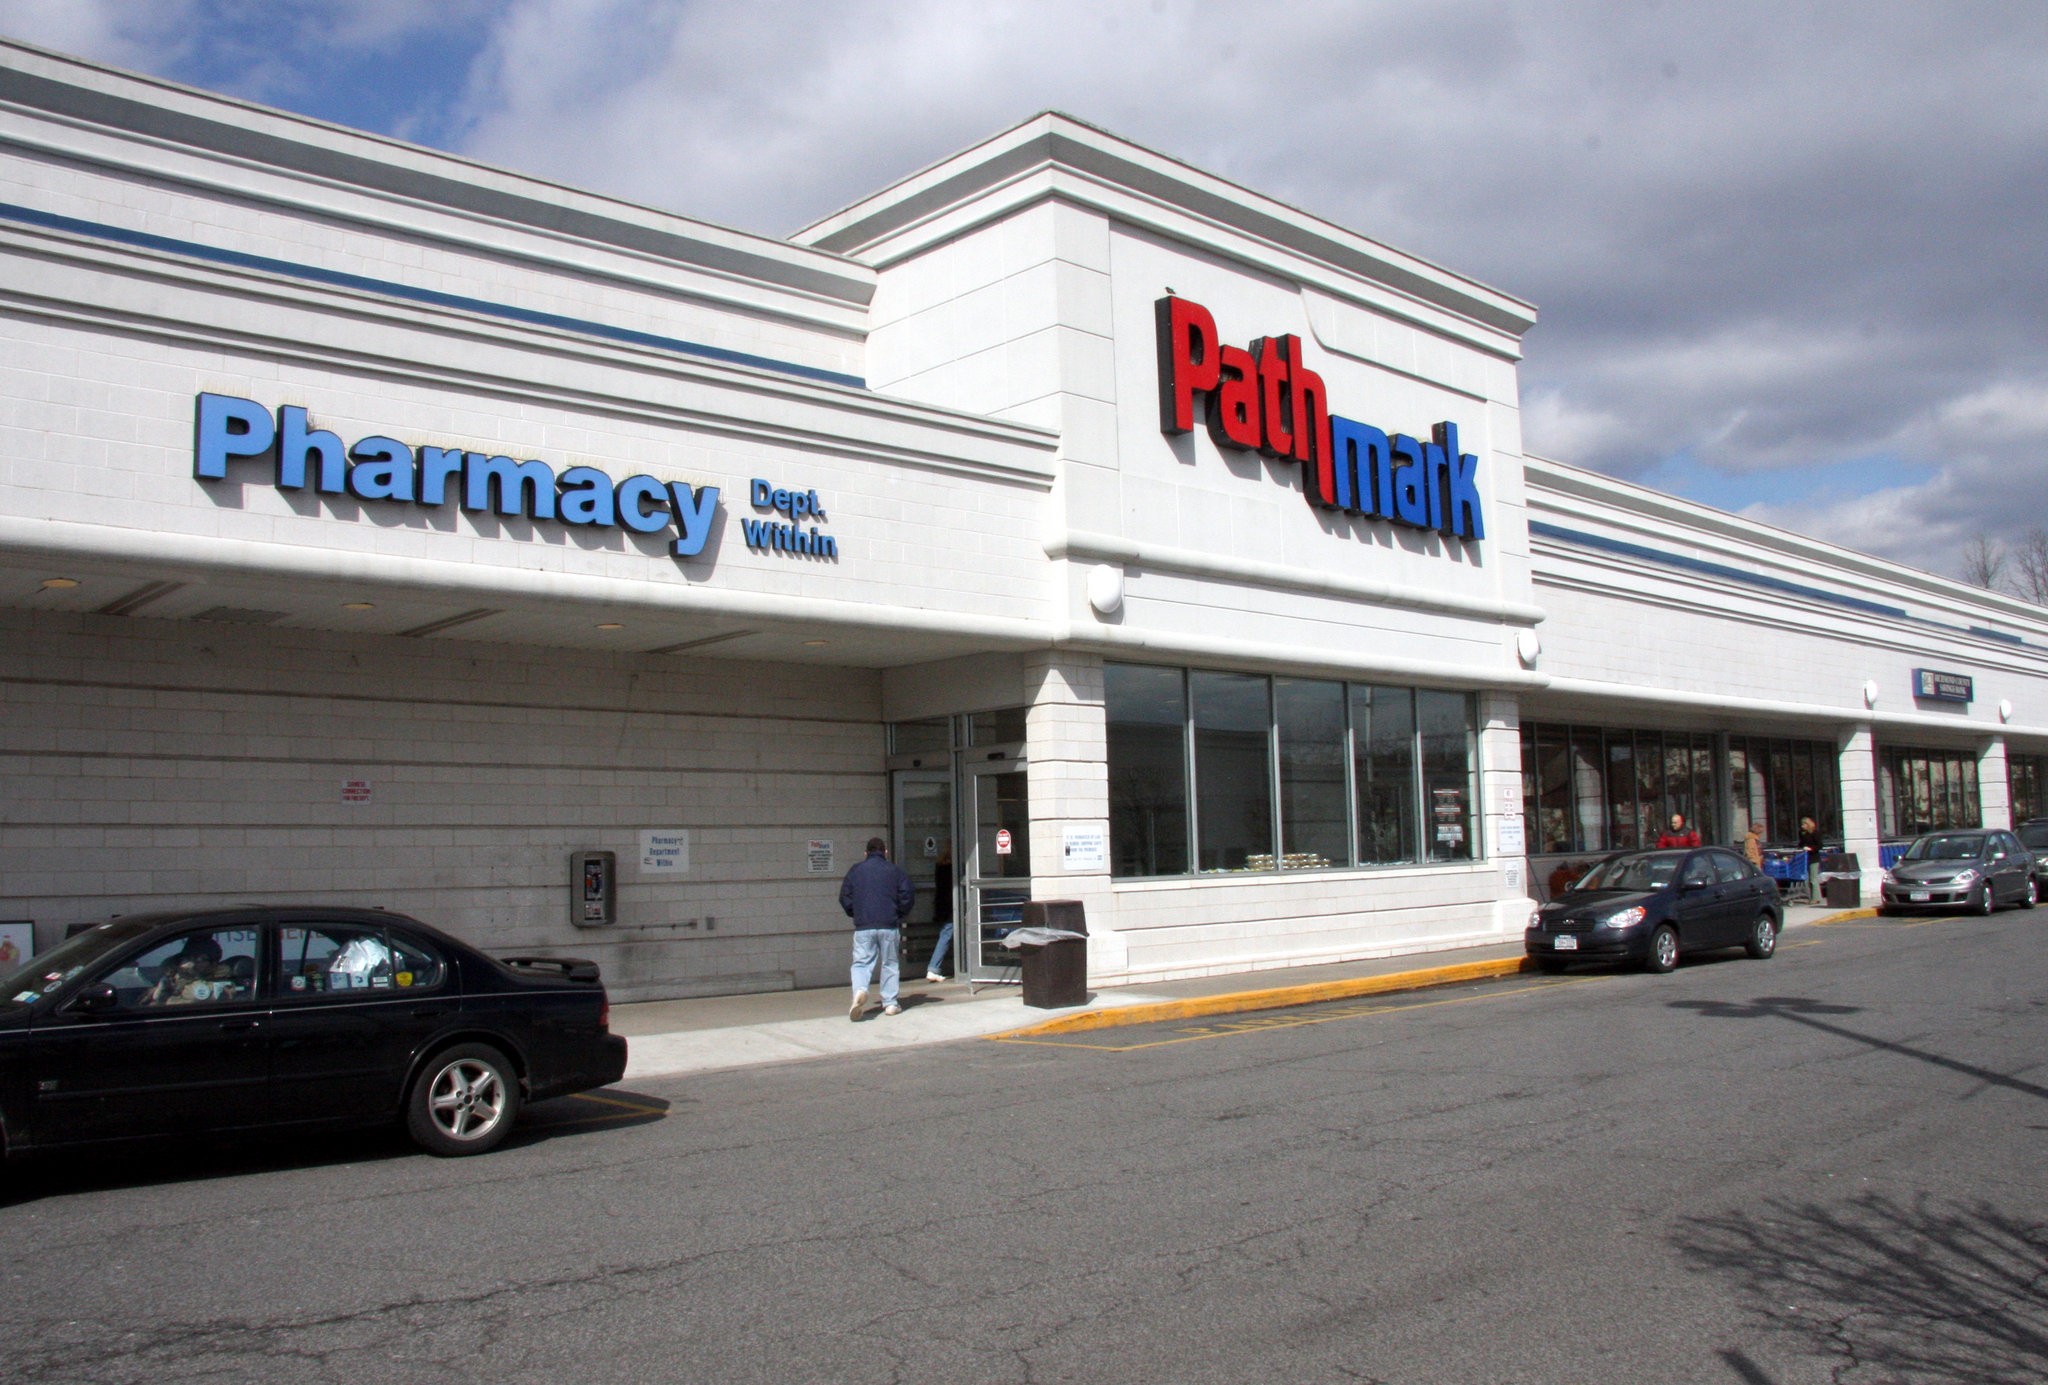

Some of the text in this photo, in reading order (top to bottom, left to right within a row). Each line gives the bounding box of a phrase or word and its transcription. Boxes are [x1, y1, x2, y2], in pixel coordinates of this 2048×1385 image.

[1154, 295, 1485, 540] Pathmark
[195, 391, 721, 558] Pharmacy
[750, 478, 826, 521] Dept.
[740, 518, 837, 557] Within
[649, 848, 680, 856] Department
[651, 836, 677, 846] Pharmacy
